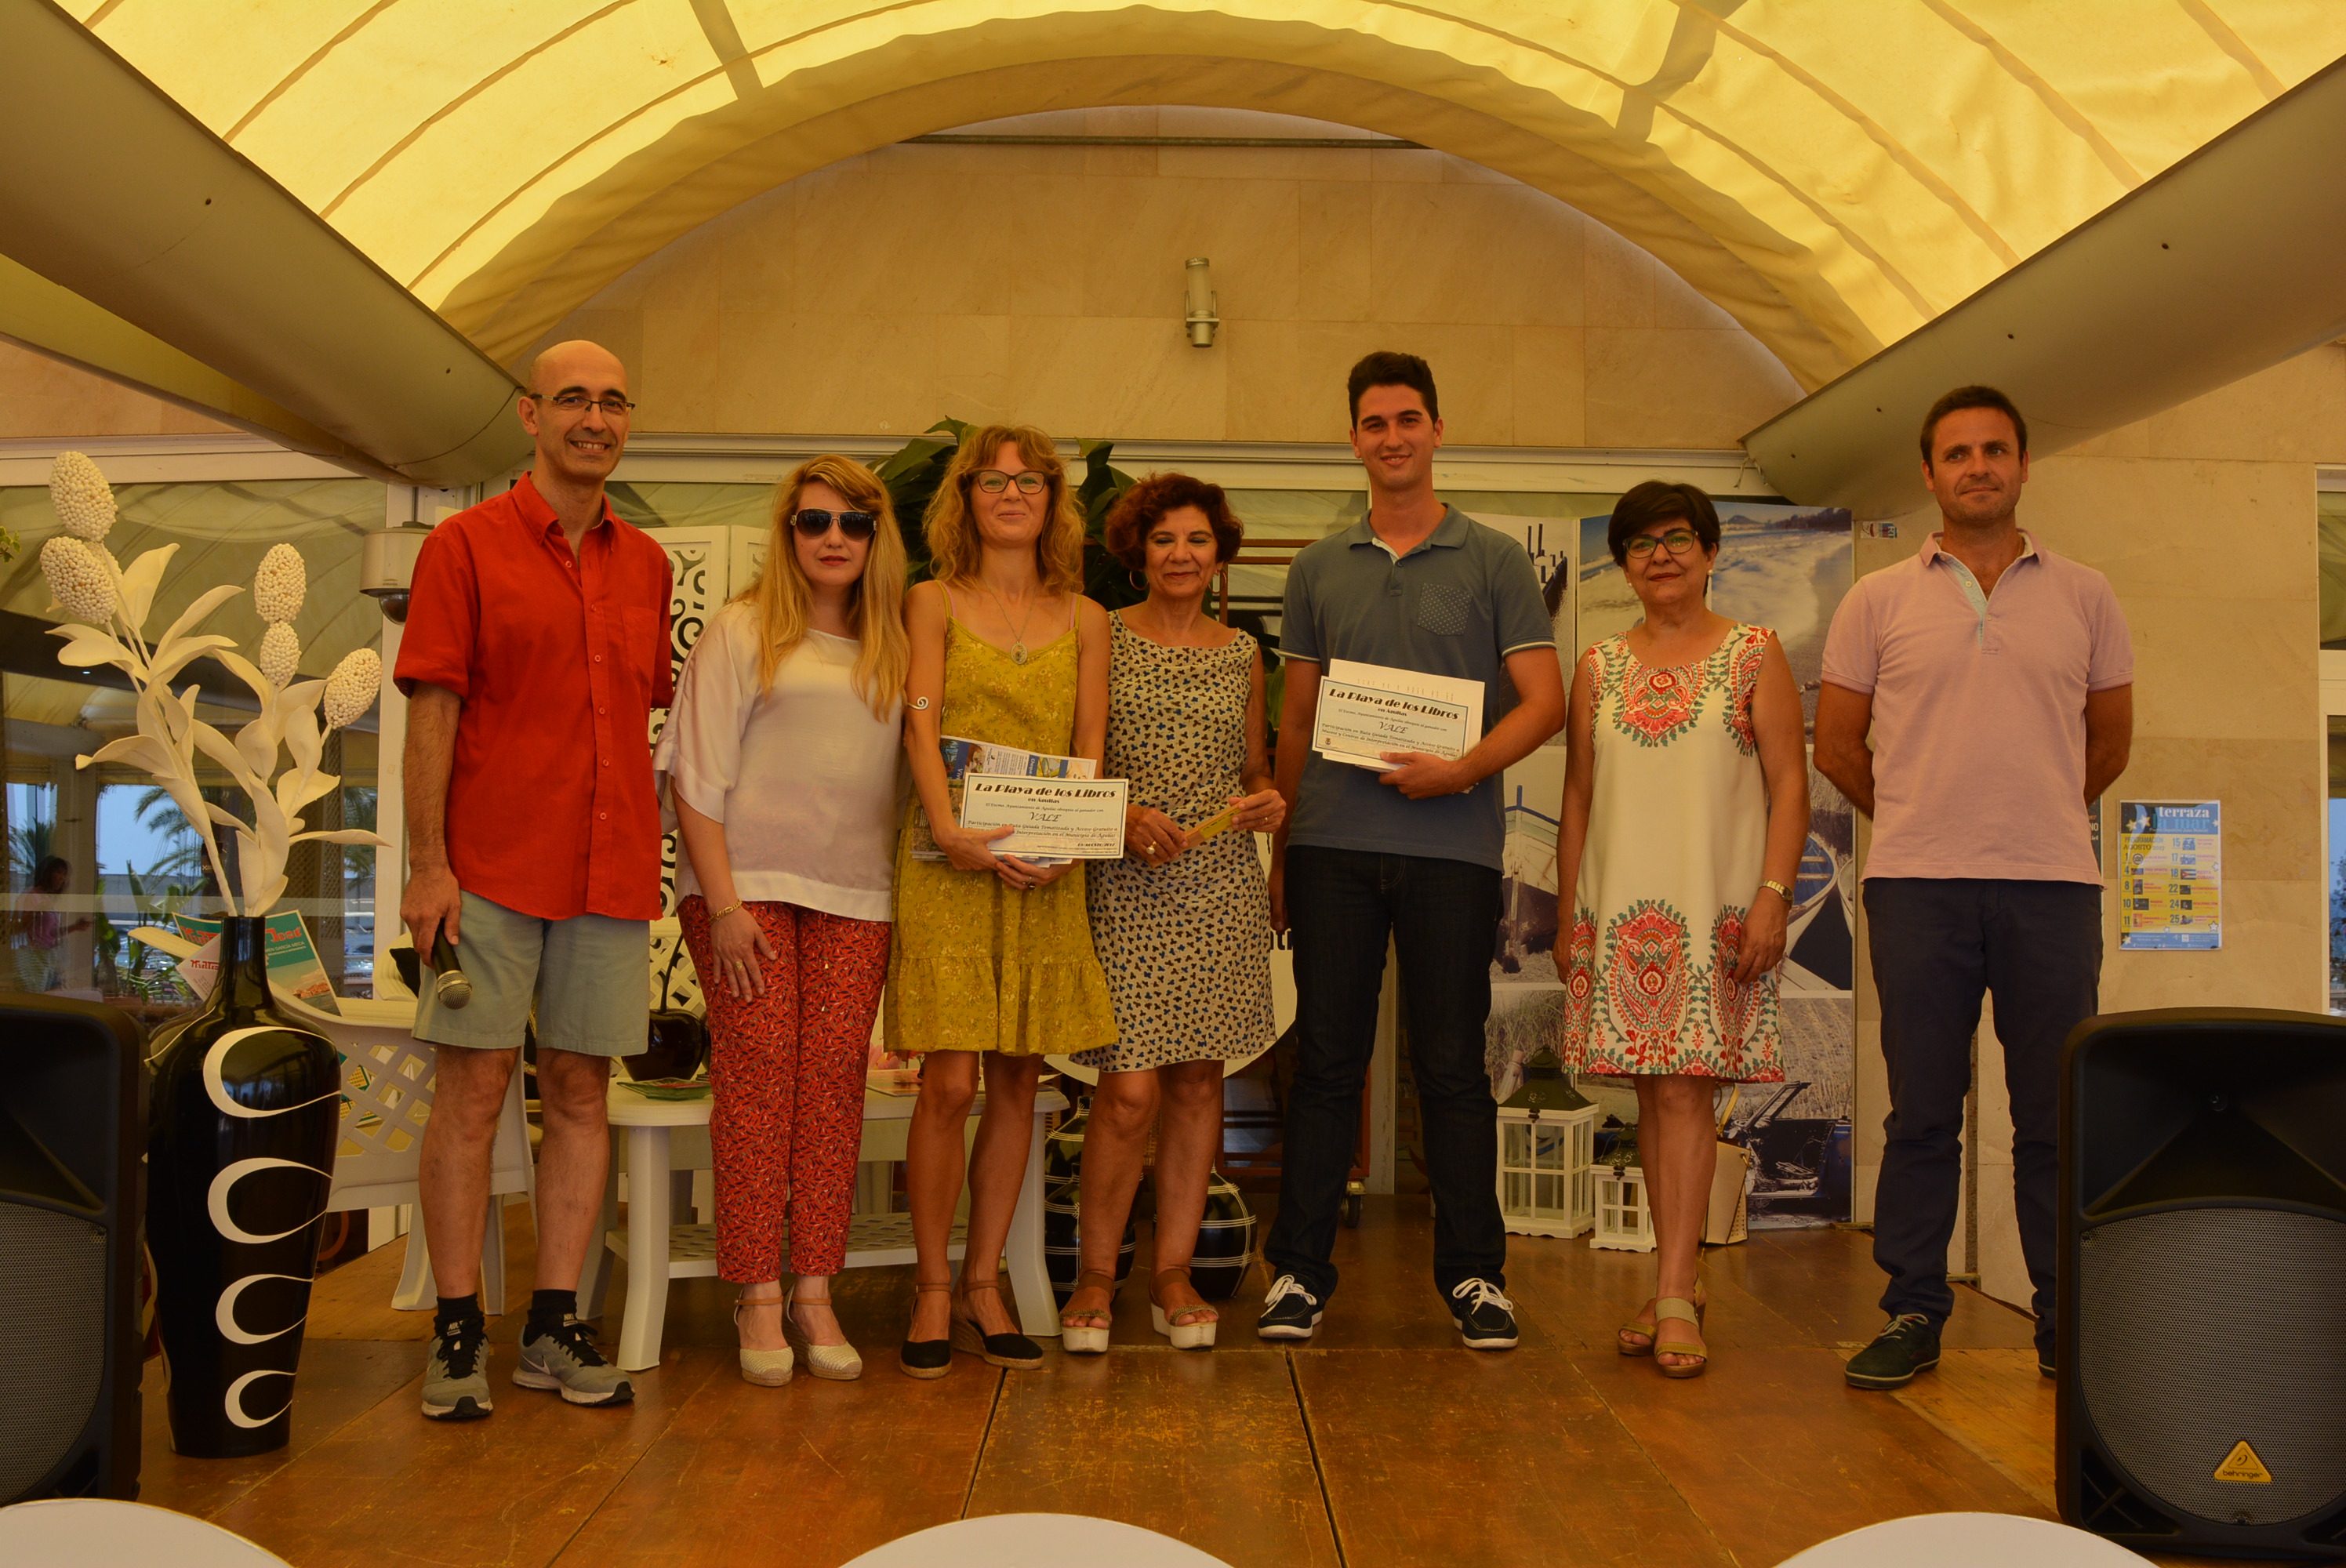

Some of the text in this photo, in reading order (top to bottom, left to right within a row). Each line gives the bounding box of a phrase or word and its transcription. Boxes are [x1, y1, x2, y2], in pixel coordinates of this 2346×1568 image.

[1328, 688, 1459, 720] La Playa de los Libros
[1321, 723, 1353, 732] Participación
[1378, 721, 1408, 735] VALE
[975, 783, 1117, 798] La Playa de los Libros
[1029, 811, 1062, 822] VALE
[2159, 806, 2210, 818] terraza
[2152, 813, 2210, 829] la mar
[2173, 837, 2181, 847] 15
[2171, 852, 2178, 862] 17
[2124, 865, 2130, 874] 4
[2170, 868, 2179, 878] 18
[2124, 880, 2130, 891] 8
[2168, 884, 2178, 893] 22
[2123, 898, 2131, 908] 10
[2170, 899, 2179, 908] 24
[2124, 916, 2130, 925] 11
[2170, 914, 2180, 924] 25
[2222, 1469, 2264, 1479] behringer
